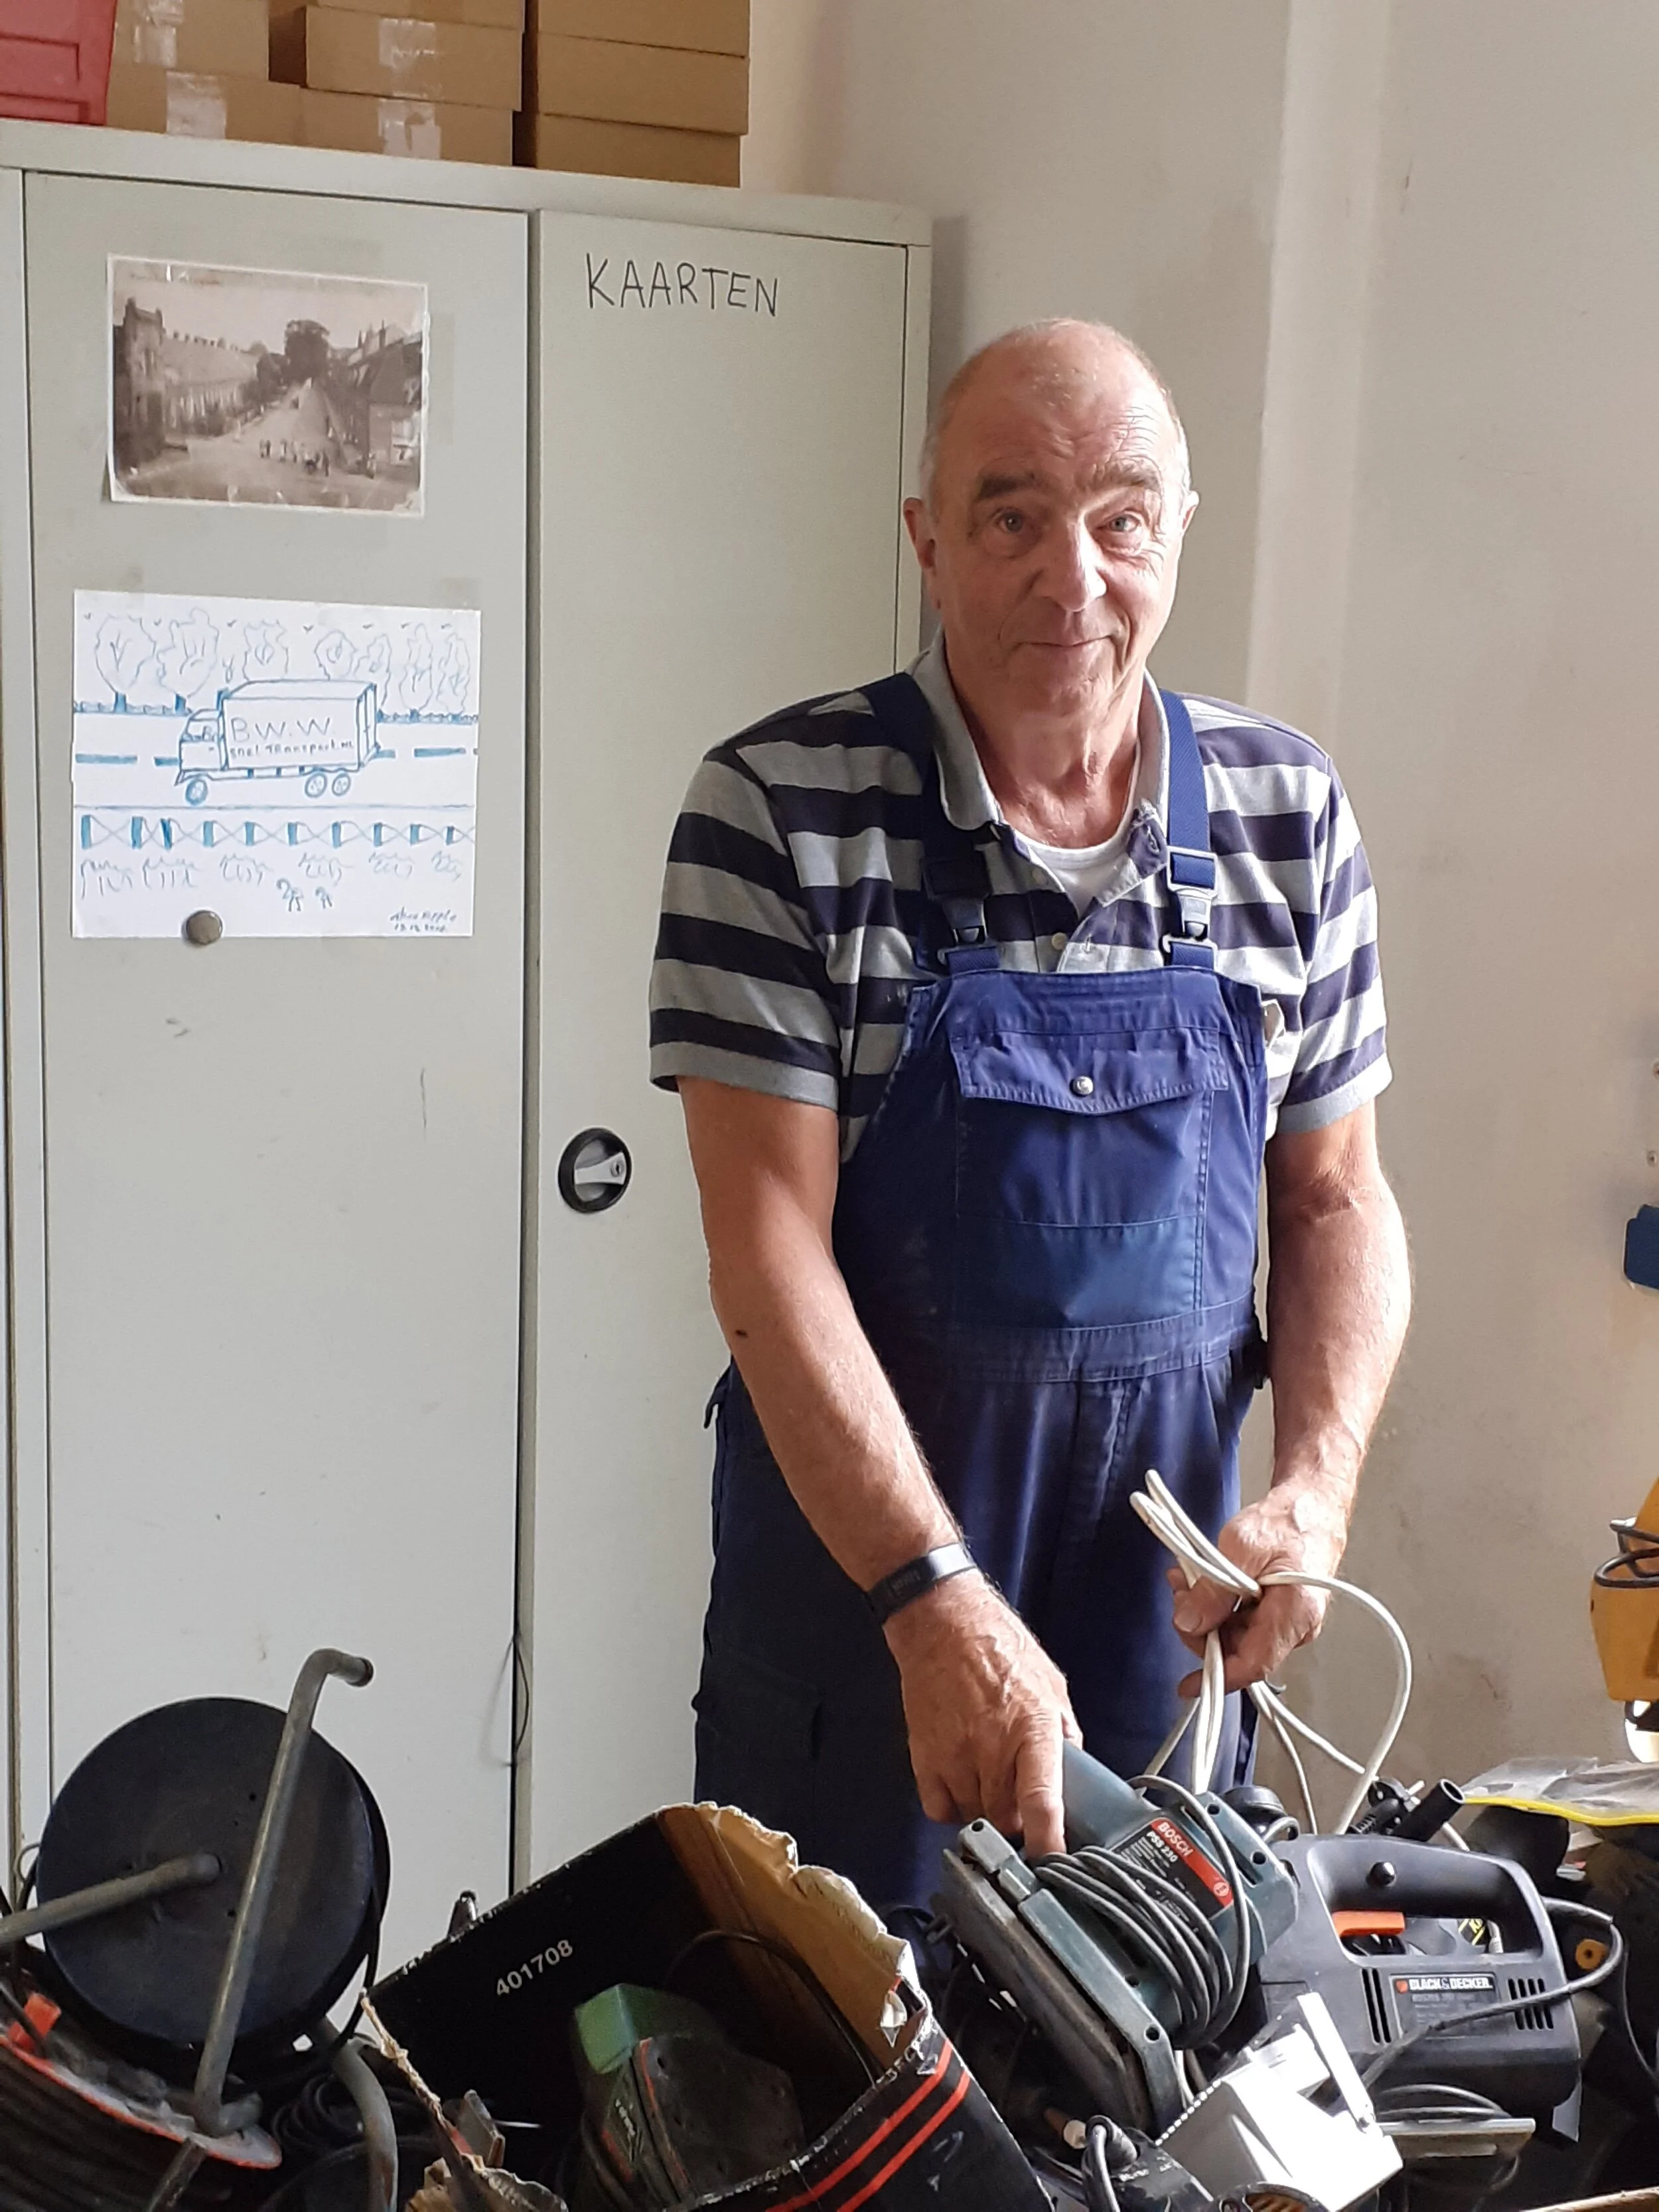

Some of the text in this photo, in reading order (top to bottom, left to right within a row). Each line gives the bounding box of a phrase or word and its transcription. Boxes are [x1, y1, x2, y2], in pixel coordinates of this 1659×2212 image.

[586, 253, 778, 317] KAARTEN
[1157, 1822, 1194, 1856] BOSCH
[496, 1939, 573, 1996] 401708
